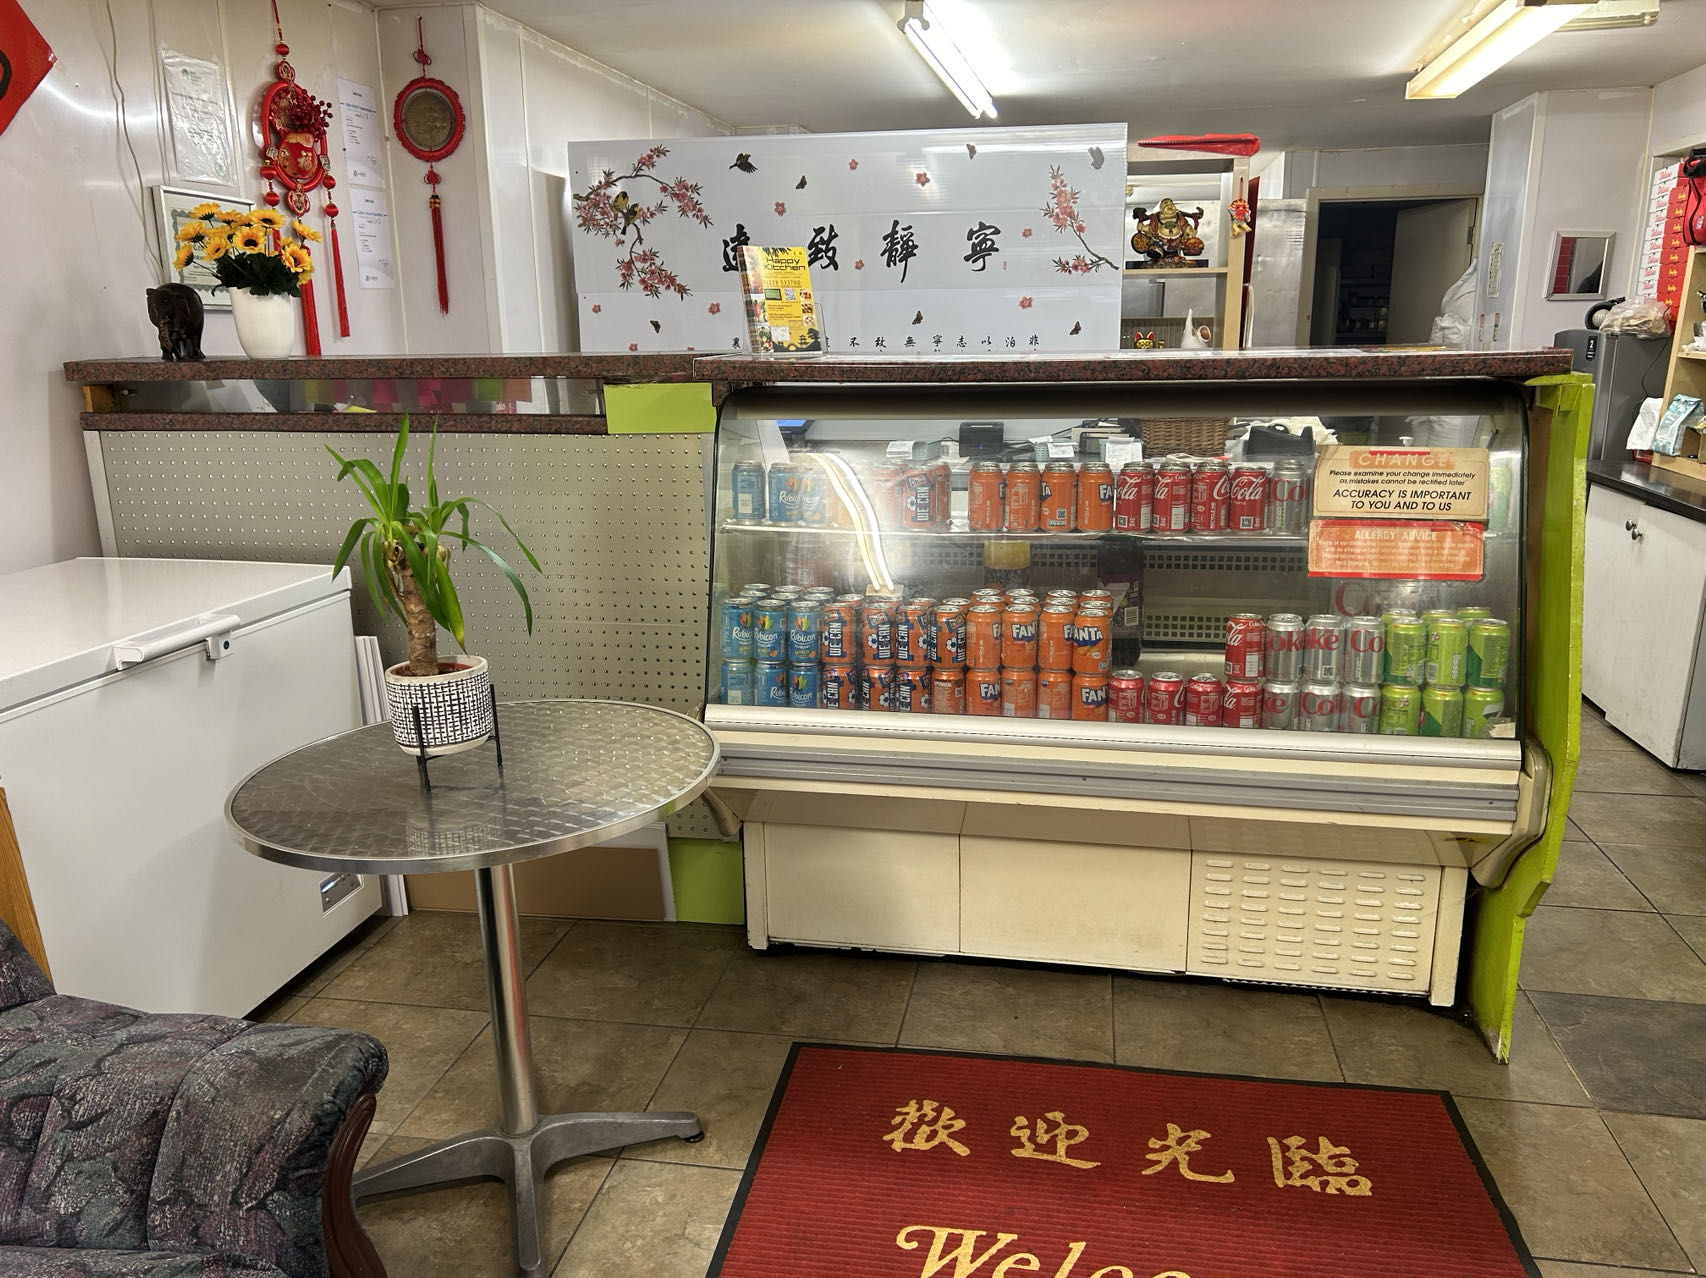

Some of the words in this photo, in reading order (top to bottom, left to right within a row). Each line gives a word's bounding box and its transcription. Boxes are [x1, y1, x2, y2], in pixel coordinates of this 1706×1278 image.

[766, 257, 800, 265] Happy
[1359, 453, 1448, 467] CHANGE
[1329, 469, 1352, 477] Please
[1402, 470, 1431, 478] change
[1431, 471, 1476, 480] immediately
[1419, 478, 1448, 486] rectified
[1448, 479, 1466, 487] later
[1333, 489, 1395, 499] ACCURACY
[1397, 490, 1407, 499] IS
[1410, 490, 1472, 501] IMPORTANT
[1351, 500, 1365, 509] TO
[1368, 500, 1391, 510] YOU
[1393, 501, 1418, 510] AND
[1421, 501, 1436, 511] TO
[1438, 502, 1452, 512] US
[790, 629, 816, 643] Rubicon
